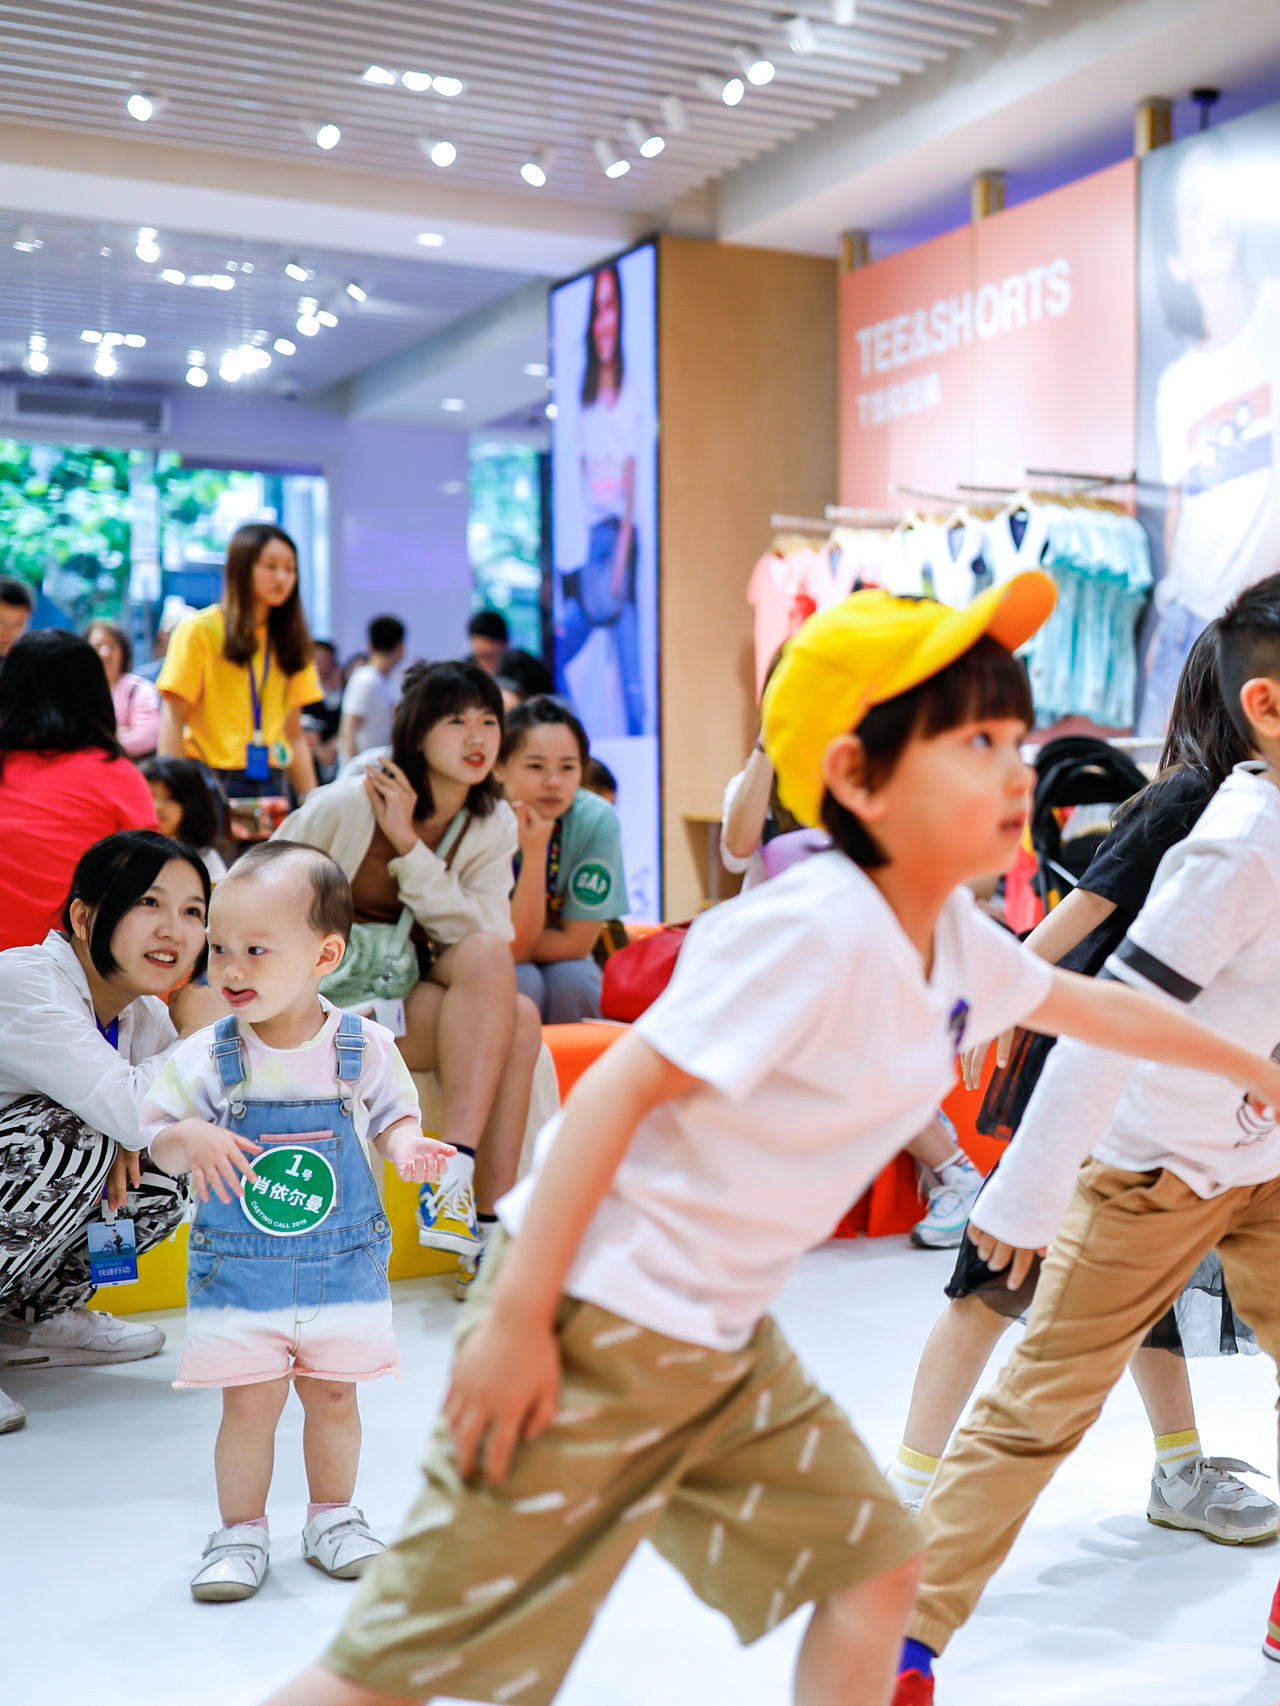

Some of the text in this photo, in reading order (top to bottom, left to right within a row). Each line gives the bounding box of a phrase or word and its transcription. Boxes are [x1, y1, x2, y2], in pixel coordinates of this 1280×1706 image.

[252, 1175, 324, 1214] 肖依尔曼
[251, 1200, 273, 1225] CASTING
[273, 1221, 290, 1229] CALL
